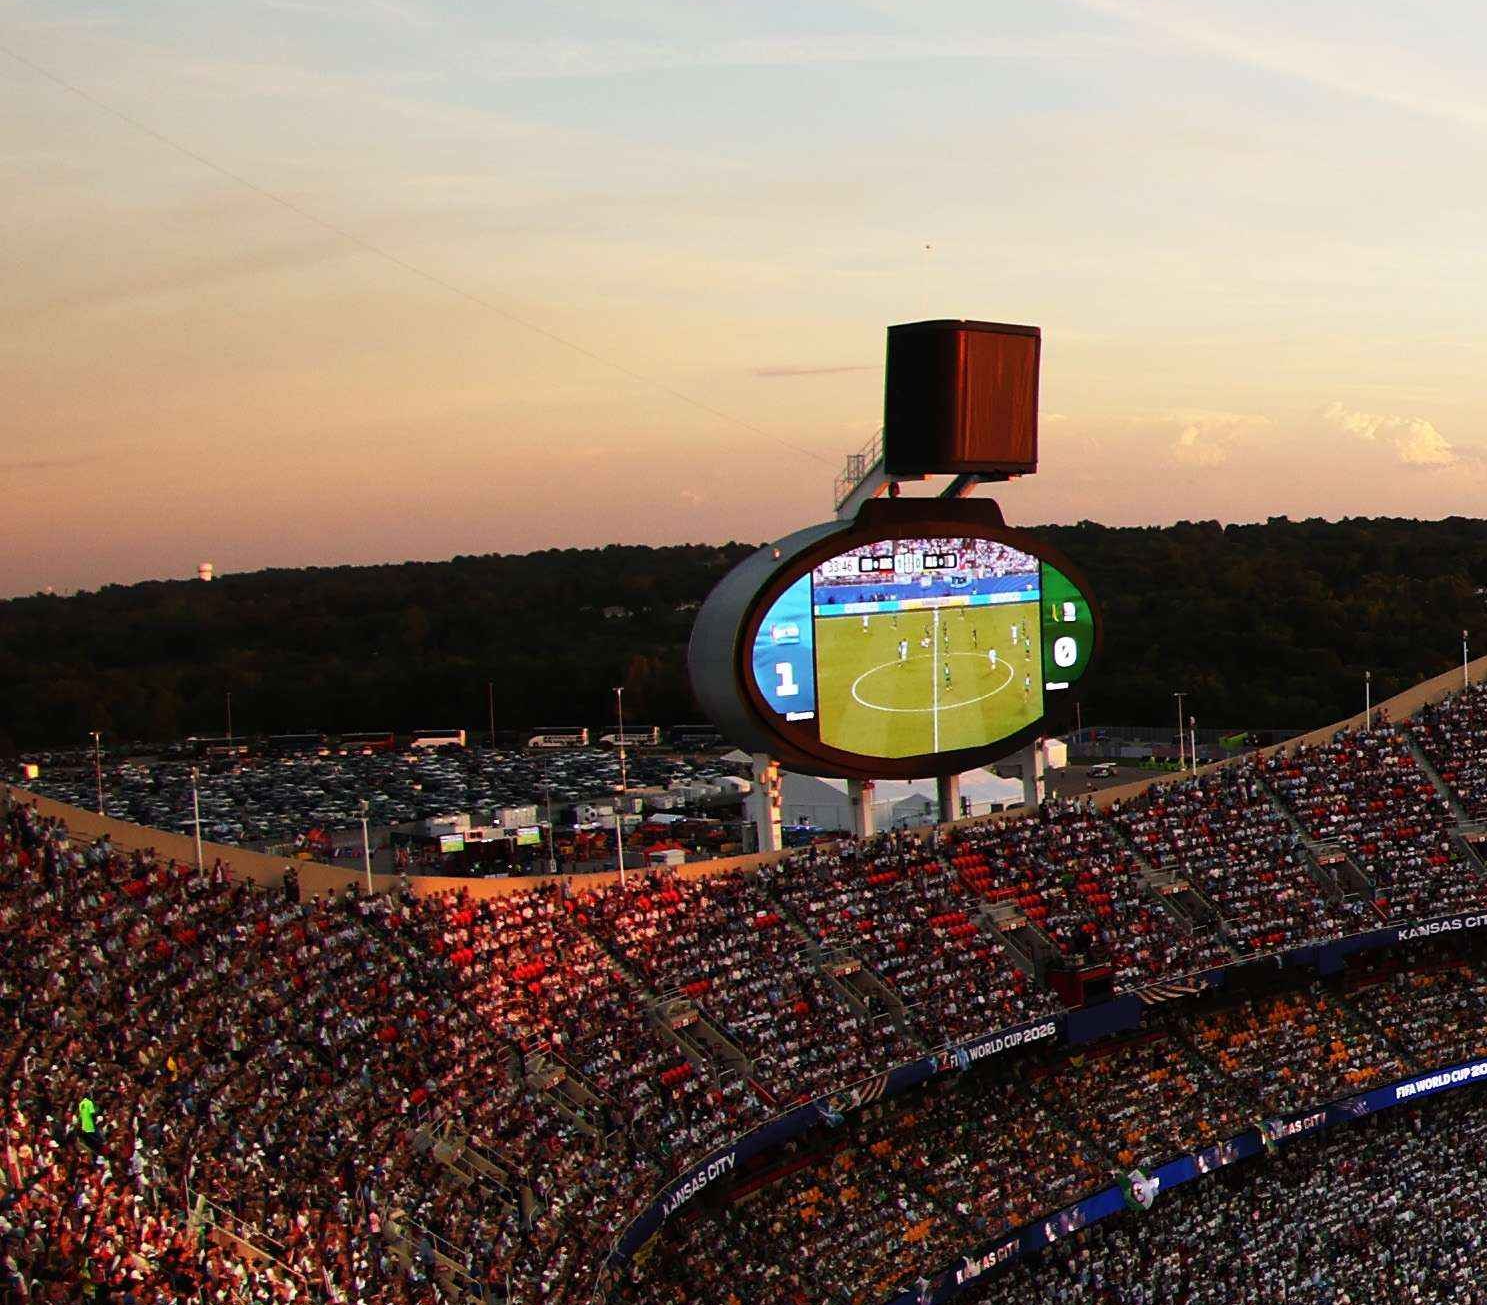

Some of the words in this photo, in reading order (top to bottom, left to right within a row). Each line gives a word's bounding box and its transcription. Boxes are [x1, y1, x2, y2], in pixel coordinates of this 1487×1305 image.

[1054, 637, 1077, 668] 0
[776, 662, 799, 696] 1
[1398, 919, 1464, 942] KANSAS
[969, 1039, 1005, 1062] WORLD
[1004, 1032, 1024, 1050] CUP
[1023, 1022, 1057, 1044] 2026
[1395, 1083, 1417, 1100] FIFA
[1414, 1073, 1451, 1094] WORLD
[1450, 1067, 1471, 1084] CUP
[662, 1170, 708, 1220] KANSAS
[706, 1152, 736, 1182] CITY
